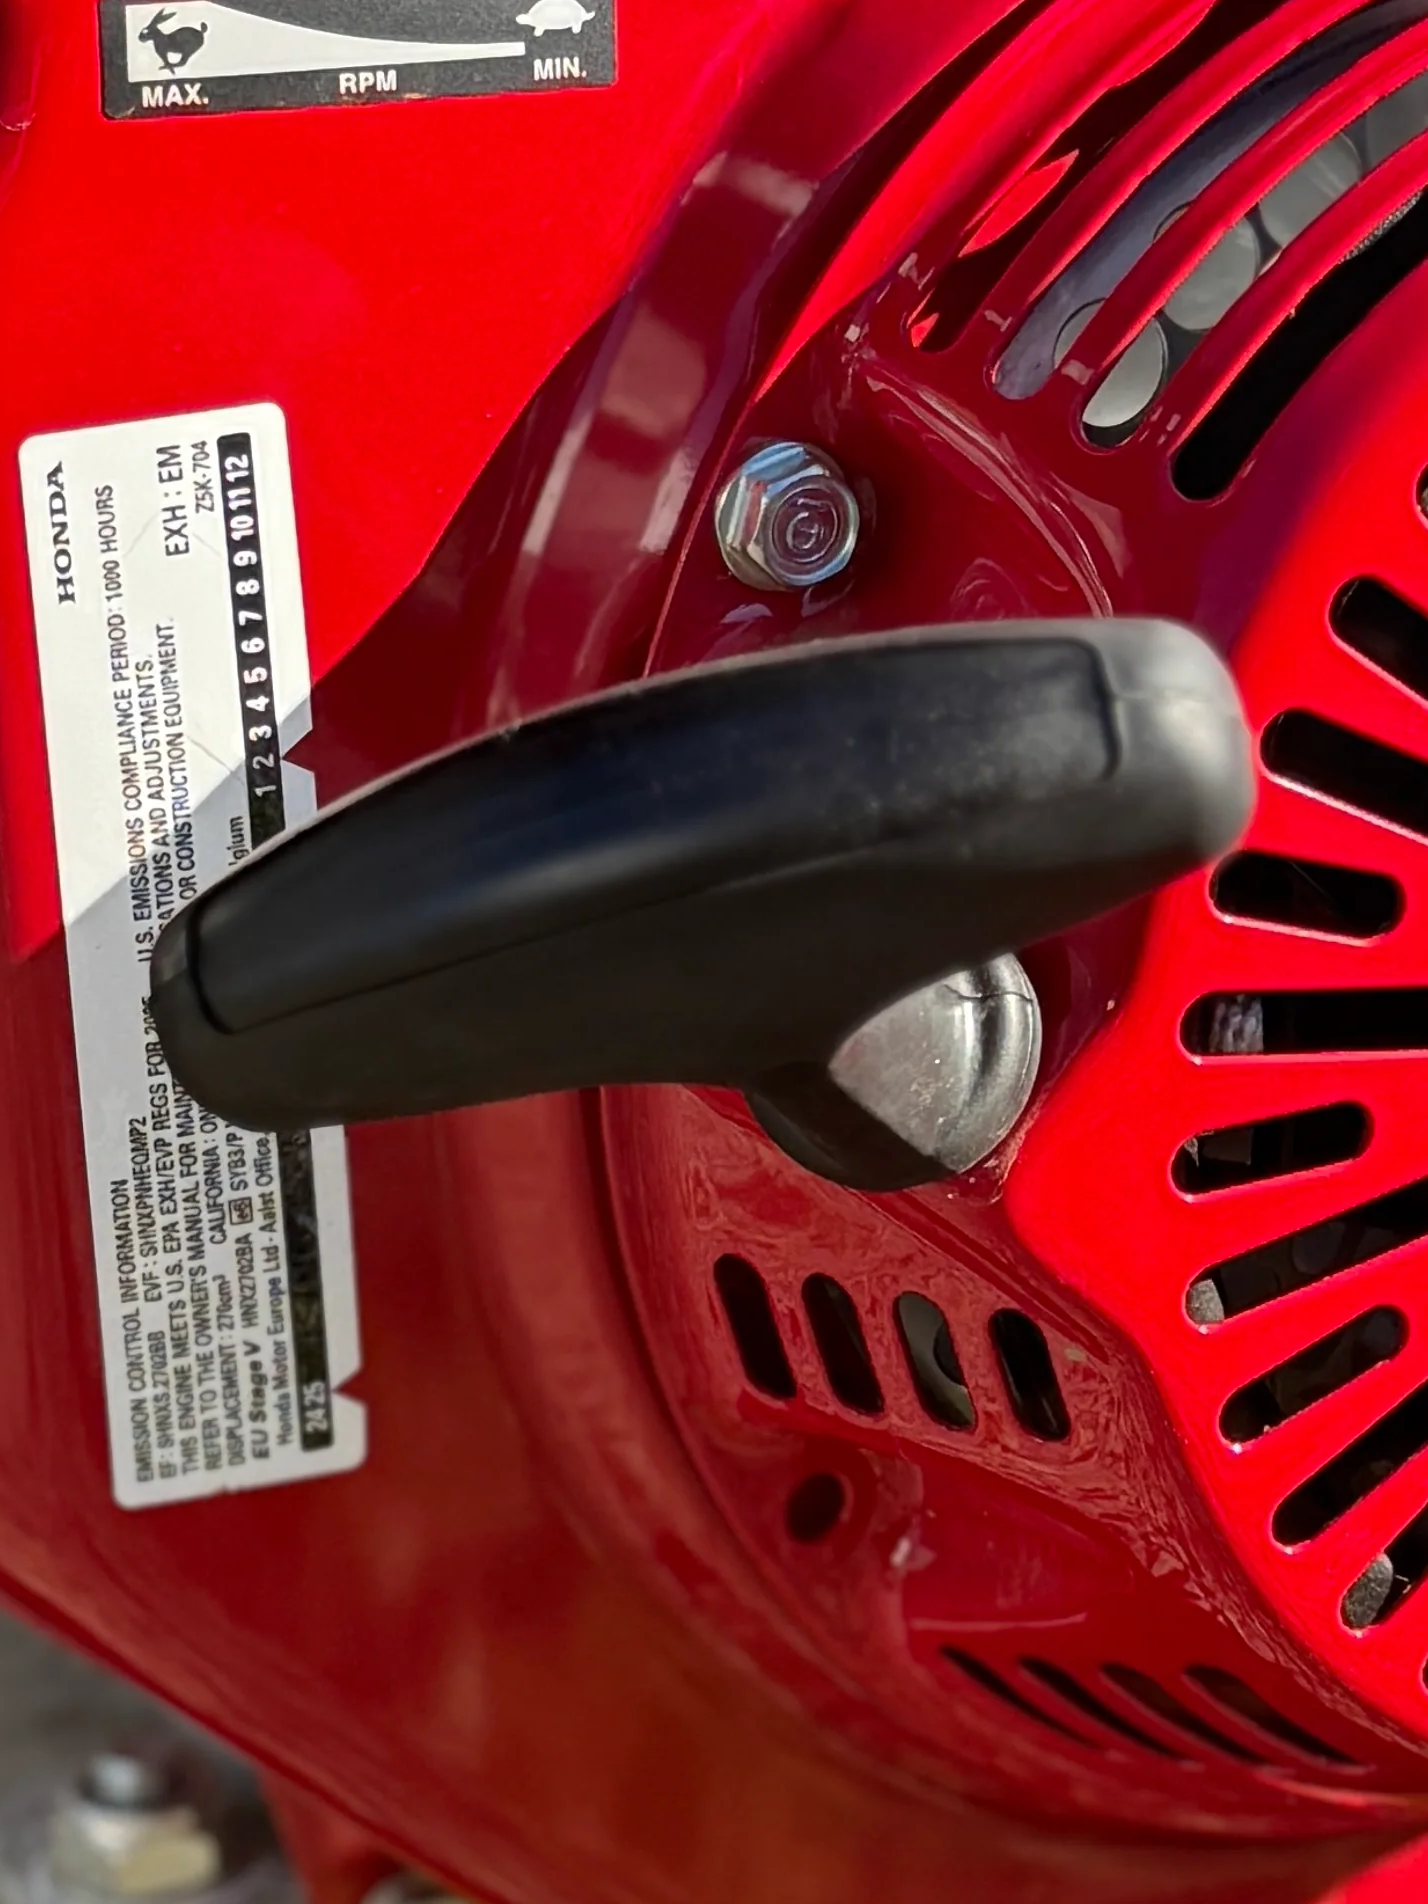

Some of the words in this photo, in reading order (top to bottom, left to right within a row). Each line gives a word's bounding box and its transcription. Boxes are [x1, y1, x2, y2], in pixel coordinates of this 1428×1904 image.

[141, 83, 209, 108] MAX.
[339, 70, 398, 95] RPM
[533, 58, 588, 81] MIN.
[156, 444, 184, 483] EM
[189, 439, 214, 514] Z5K-704
[223, 453, 250, 483] 12
[94, 483, 118, 553] HOURS
[226, 486, 252, 511] 11
[44, 460, 76, 605] HONDA
[161, 503, 190, 556] EXH
[228, 513, 255, 541] 10
[232, 548, 257, 567] 9
[101, 559, 123, 602] 1000
[235, 577, 260, 596] 8
[238, 607, 262, 625] 7
[240, 636, 265, 654] 6
[243, 665, 267, 683] 5
[245, 693, 270, 713] 4
[134, 654, 165, 802] ADJUSTMENTS.
[248, 723, 272, 741] 3
[113, 688, 141, 812] COMPLIANCE
[251, 752, 275, 770] 2
[165, 731, 195, 871] CONSTRUCTION
[253, 784, 277, 797] 1
[148, 807, 169, 847] AND
[125, 817, 151, 921] EMISSIONS
[178, 874, 197, 900] OR
[144, 1040, 165, 1076] FOR
[148, 1082, 170, 1131] REGS
[153, 1135, 177, 1215] EXH/EVP
[177, 1141, 197, 1178] FOR
[180, 1181, 205, 1261] MANUAL
[256, 1191, 277, 1234] Aalst
[109, 1178, 138, 1303] INFORMATION
[160, 1220, 181, 1253] EPA
[261, 1244, 280, 1272] Ltd
[163, 1259, 184, 1293] U.S.
[233, 1232, 259, 1328] HNX2702BA
[188, 1264, 212, 1347] OWNER'S
[263, 1275, 287, 1335] Europe
[167, 1298, 190, 1358] MEETS
[242, 1338, 261, 1356] V
[121, 1307, 146, 1393] CONTROL
[195, 1350, 215, 1386] THE
[268, 1338, 290, 1390] Motor
[173, 1363, 196, 1430] ENGINE
[198, 1388, 218, 1414] TO
[243, 1358, 270, 1424] Stage
[129, 1396, 154, 1483] EMISSION
[273, 1391, 294, 1445] Honda
[179, 1435, 200, 1474] THIS
[201, 1417, 223, 1470] REFER
[250, 1427, 270, 1460] EU
